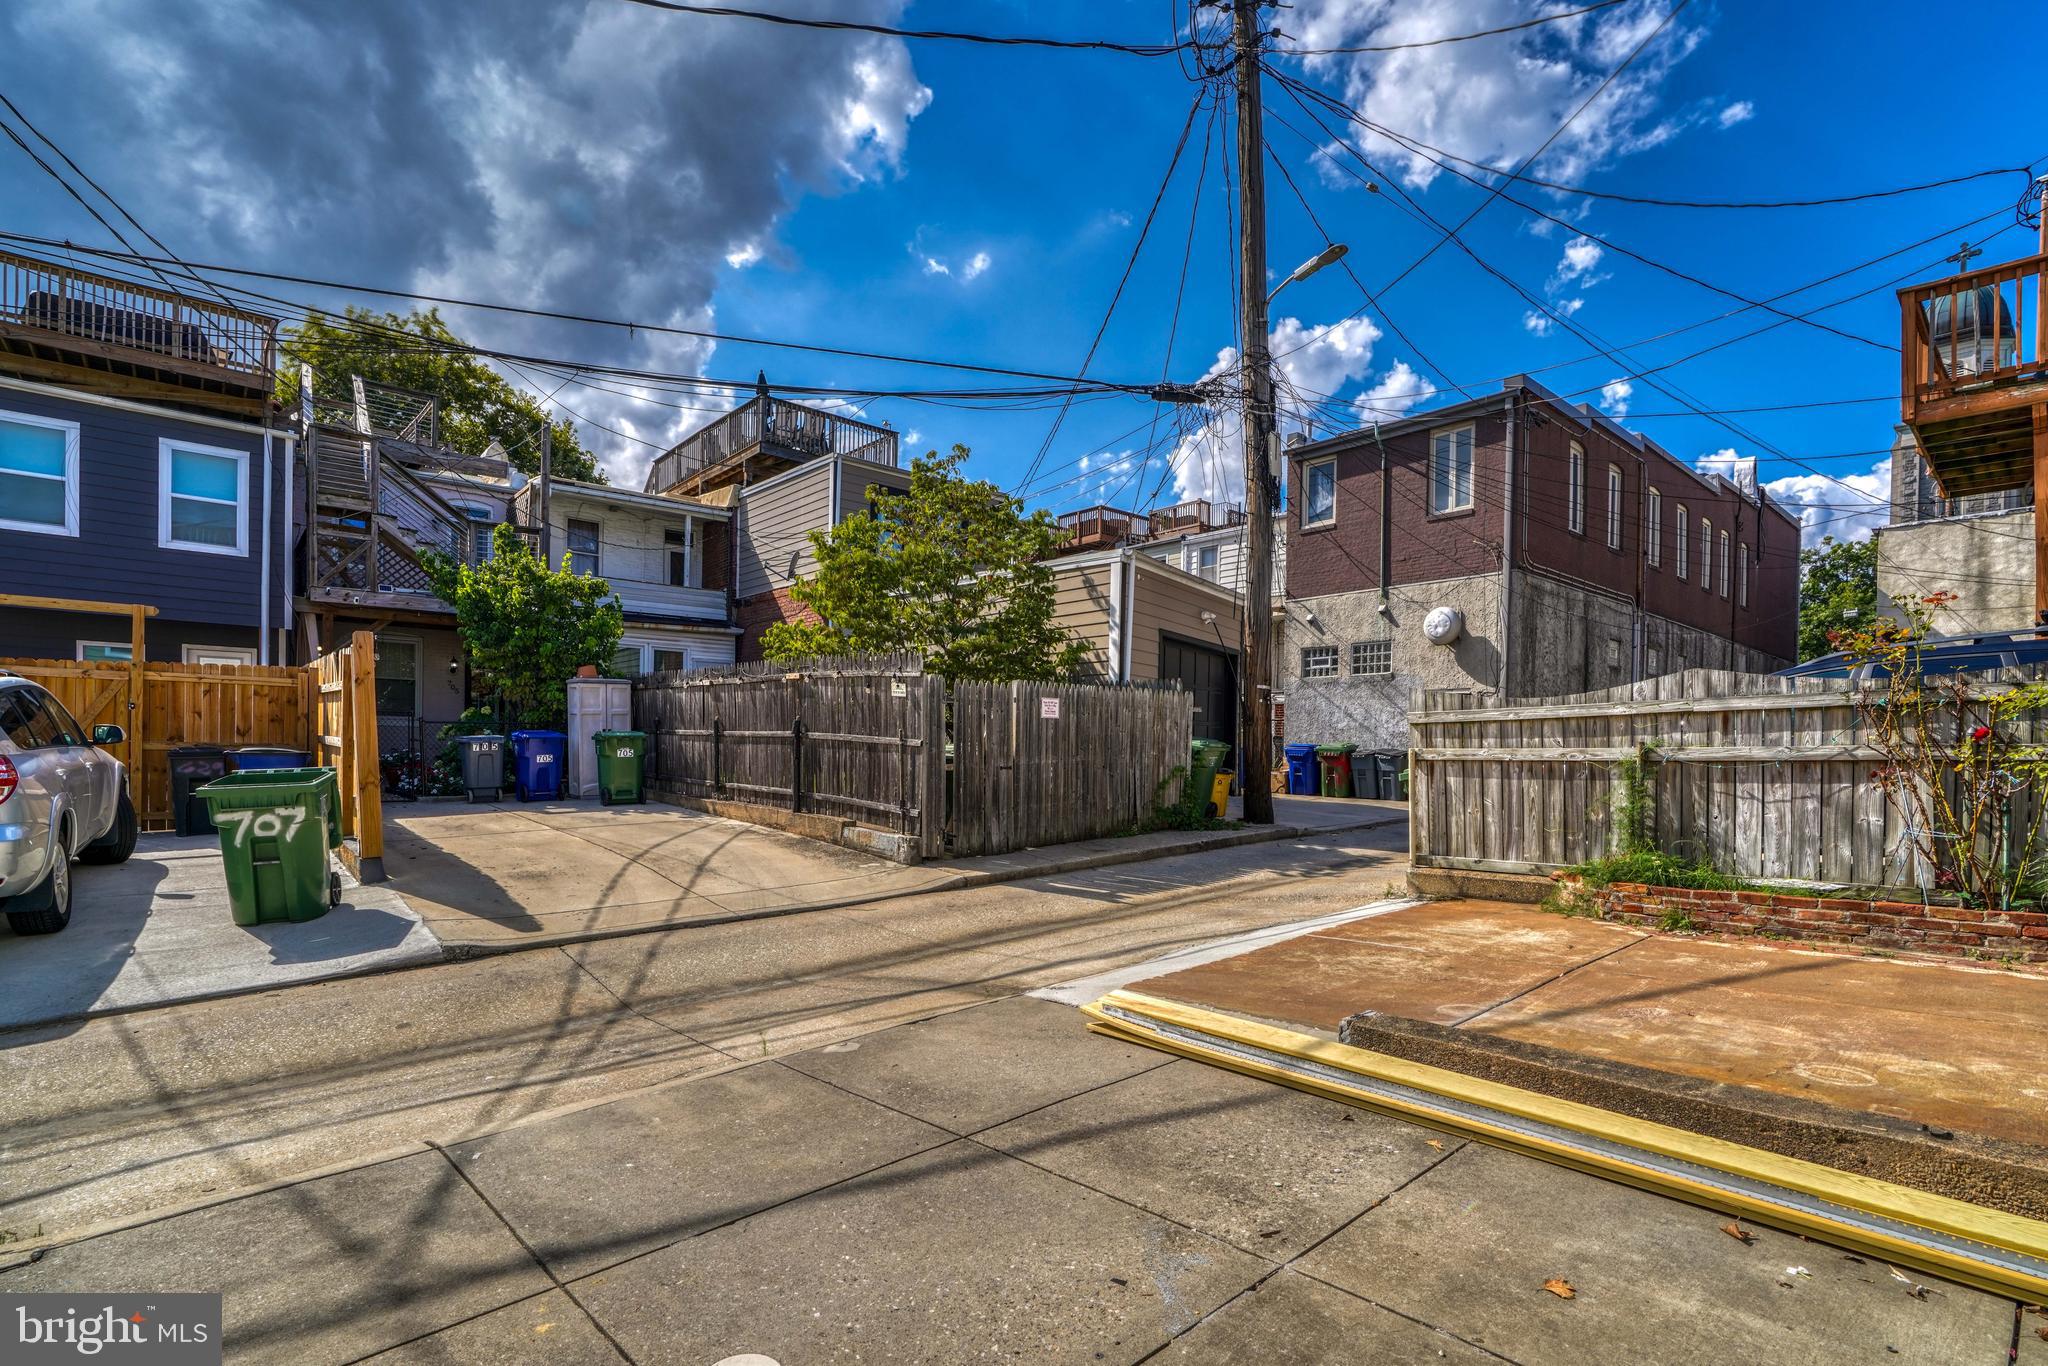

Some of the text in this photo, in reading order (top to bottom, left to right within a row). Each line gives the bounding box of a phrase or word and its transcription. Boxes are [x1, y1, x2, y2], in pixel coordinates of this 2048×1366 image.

[473, 743, 498, 751] 705
[617, 749, 634, 757] 705
[537, 754, 553, 762] 705
[213, 806, 306, 848] 707
